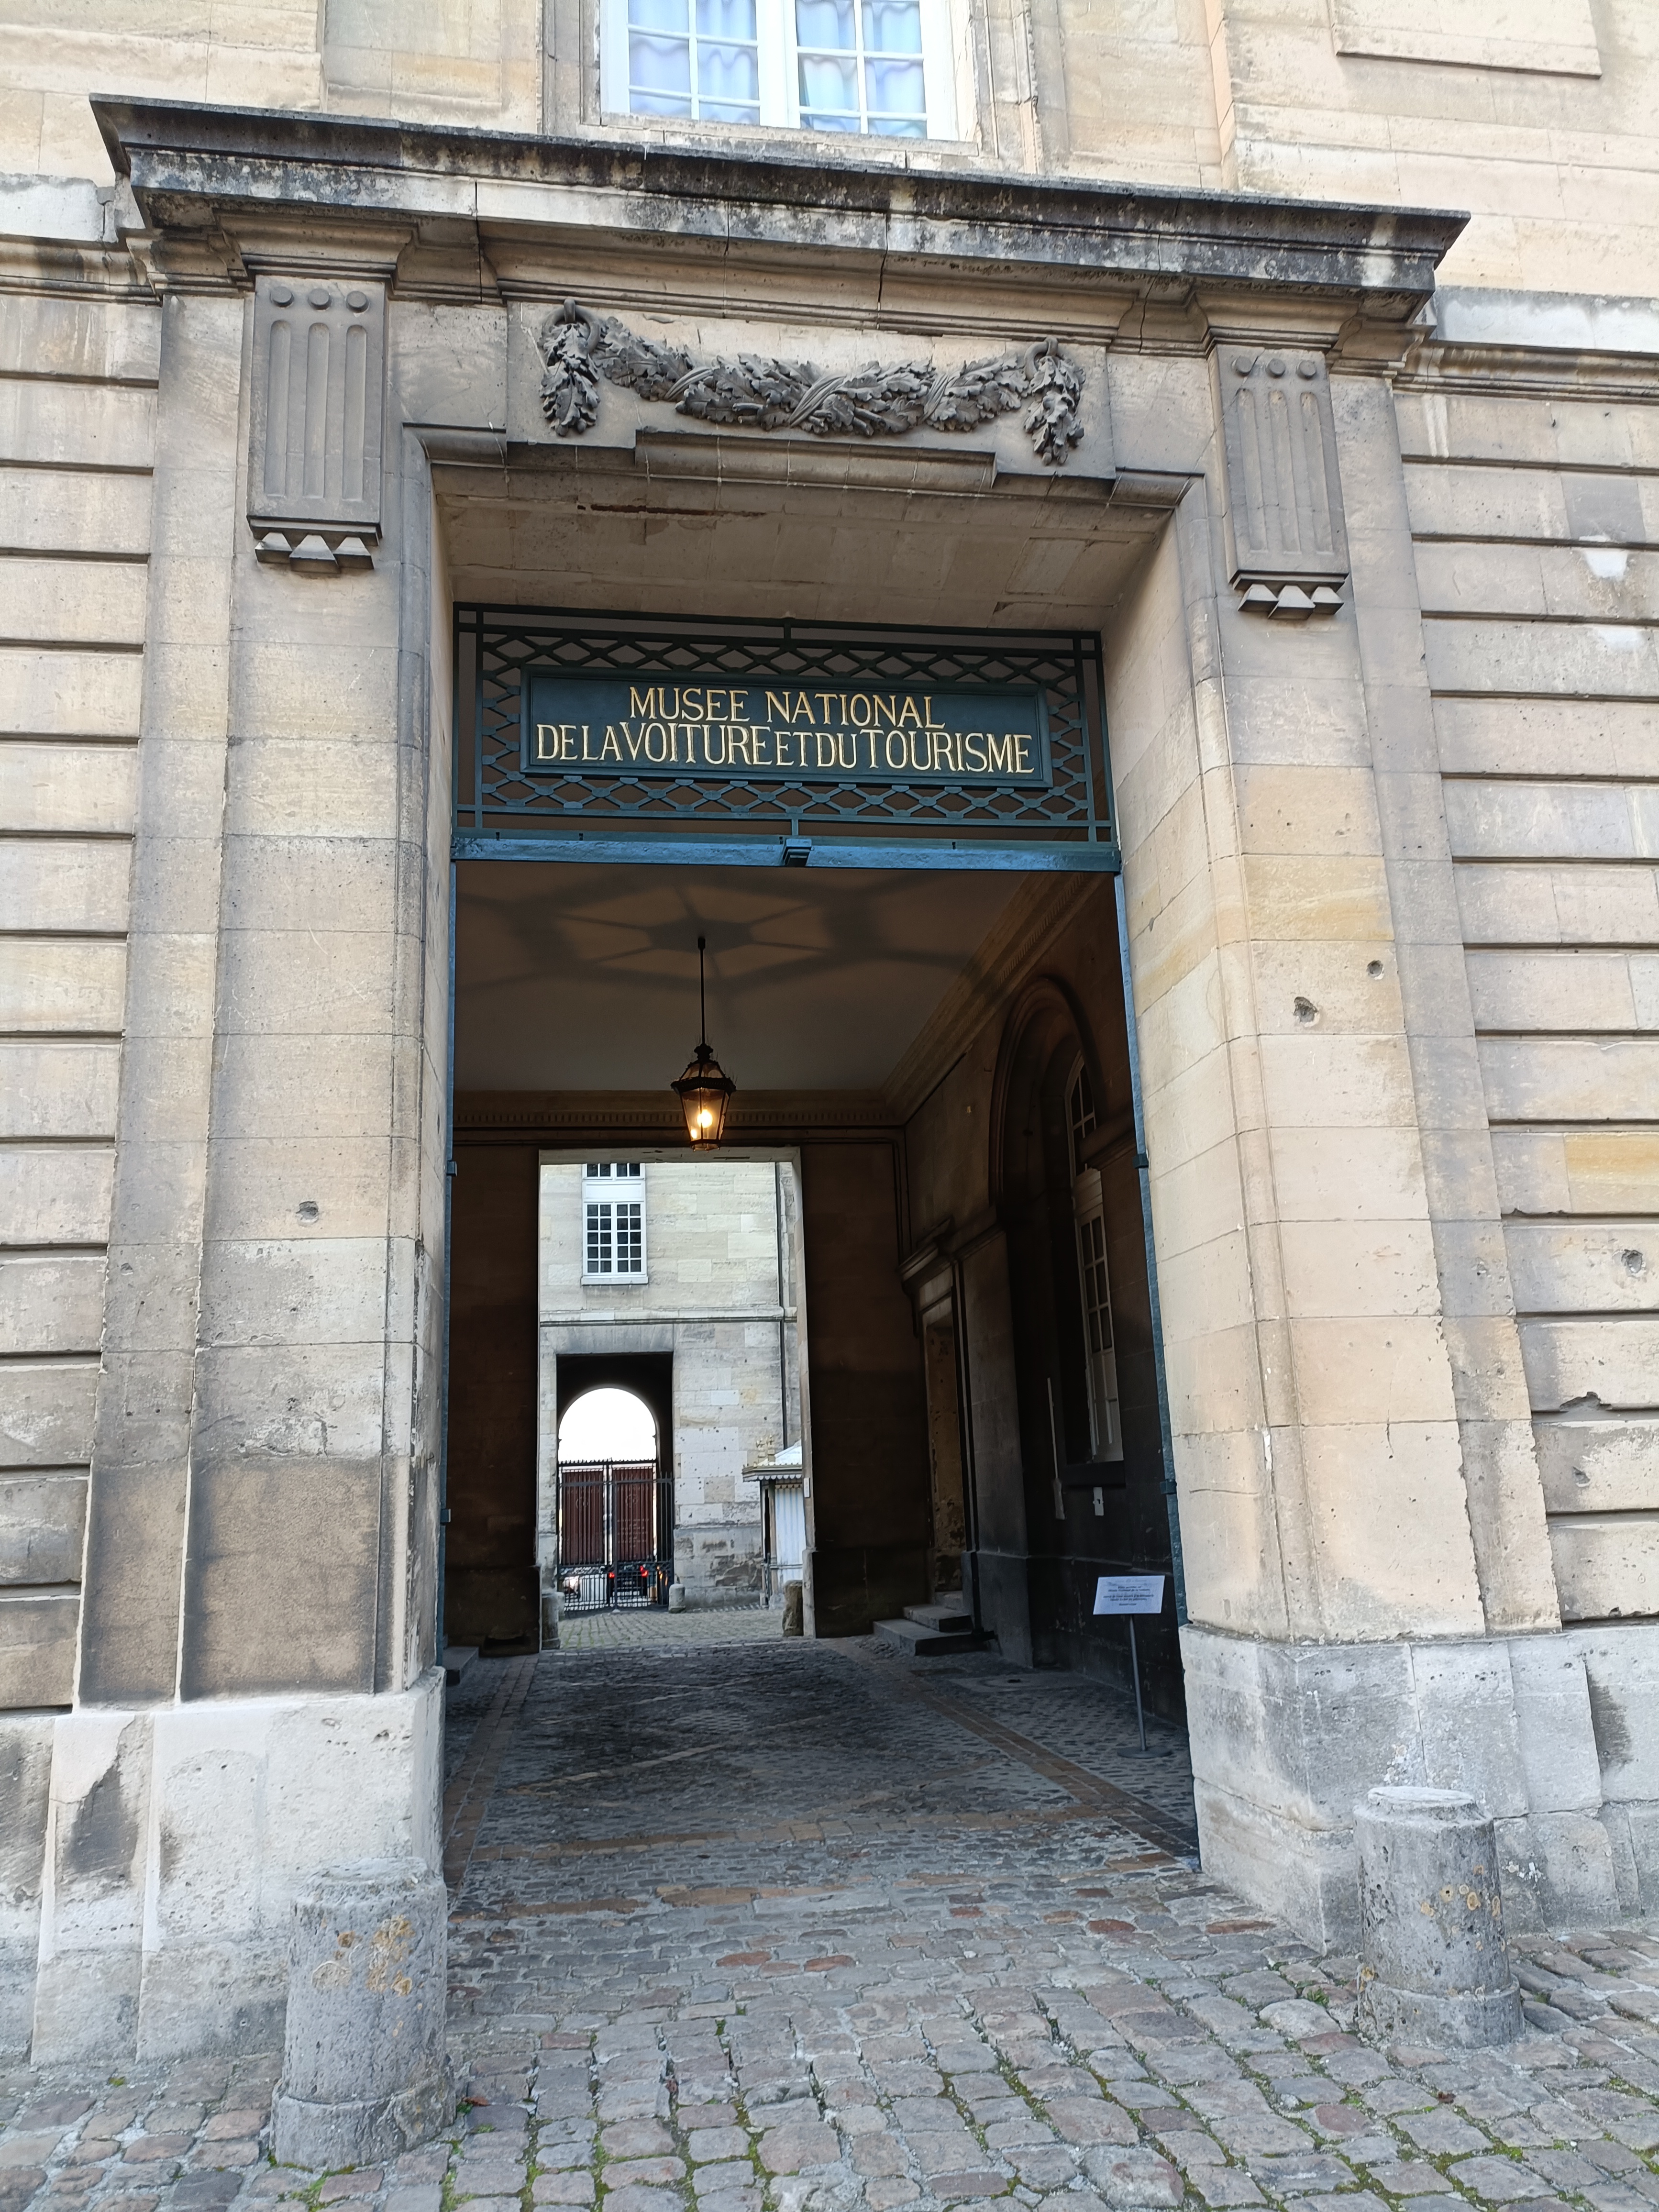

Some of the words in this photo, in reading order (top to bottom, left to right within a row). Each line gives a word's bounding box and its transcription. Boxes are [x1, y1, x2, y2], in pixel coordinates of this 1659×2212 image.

[630, 686, 750, 722] MUSEE
[764, 691, 945, 730] NATIONAL
[536, 724, 578, 761] DE
[581, 725, 623, 761] LA
[619, 721, 773, 765] VOITURE
[774, 730, 813, 767] ET
[815, 732, 857, 769] DU
[860, 729, 1035, 774] TOURISME
